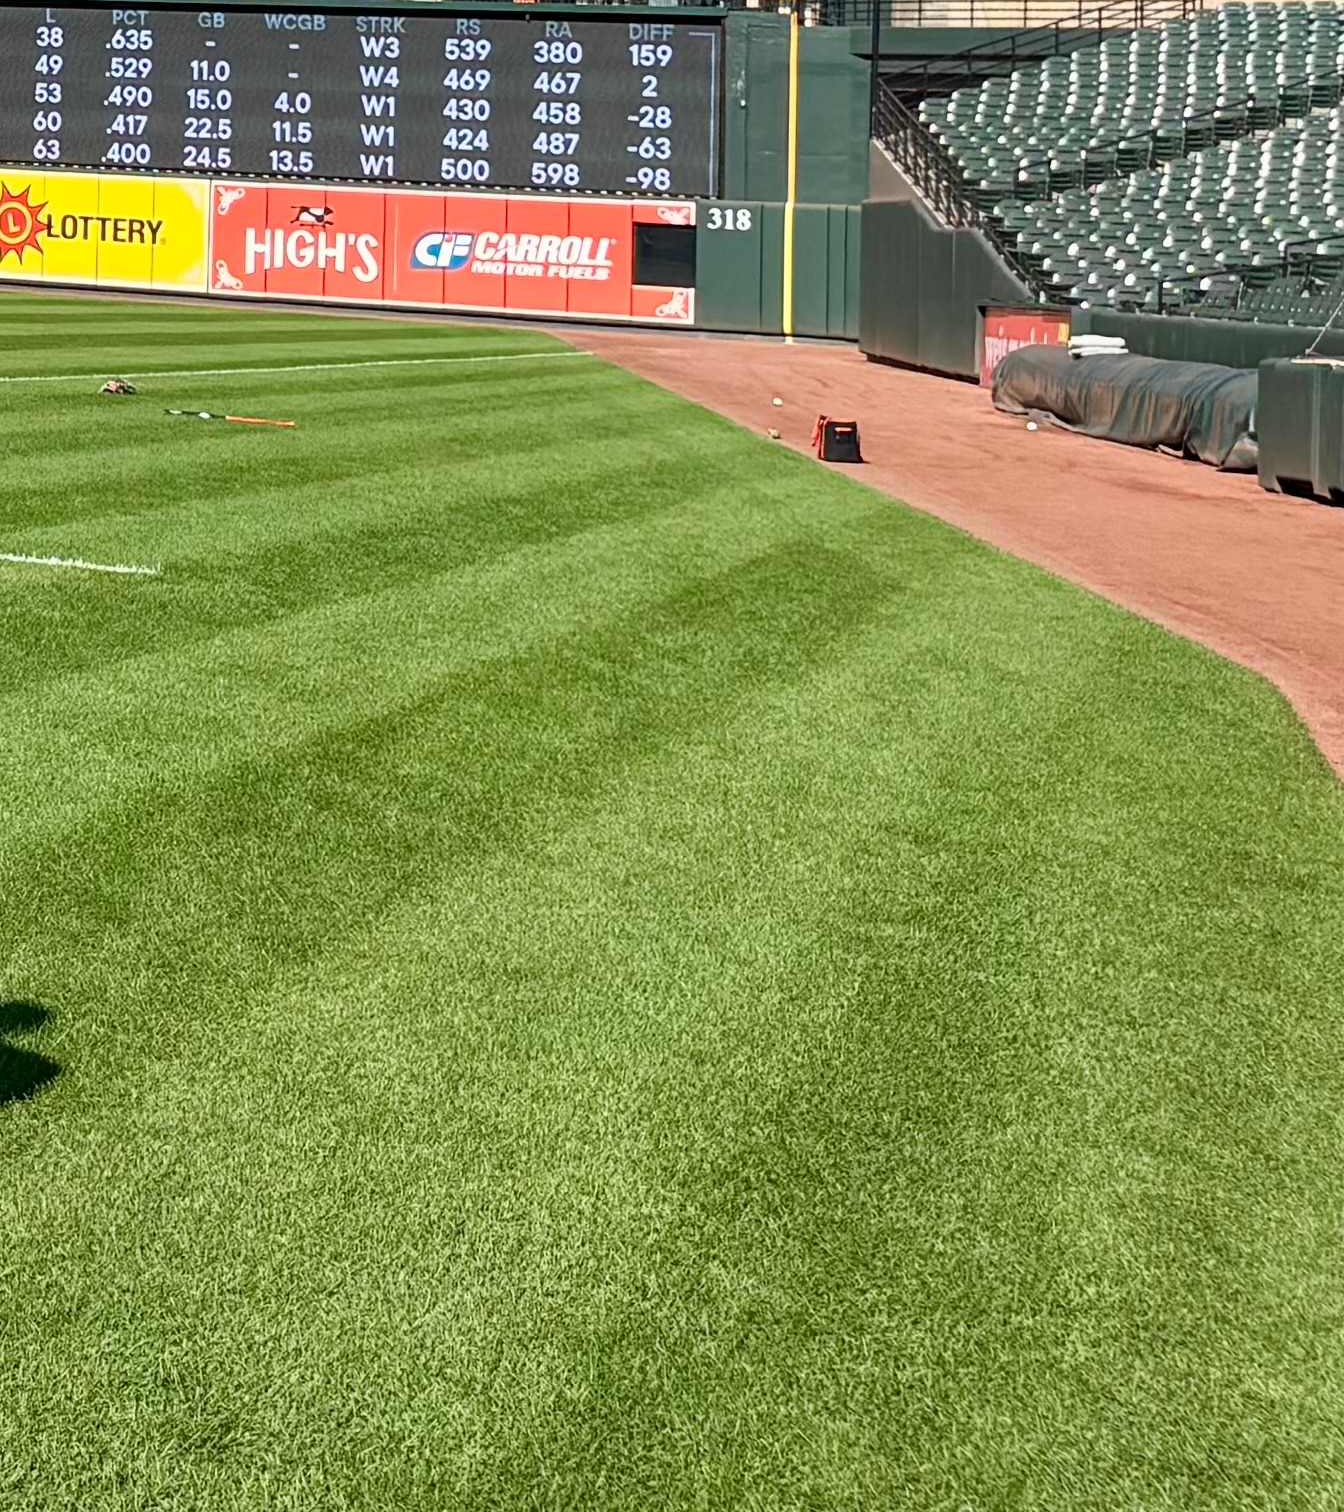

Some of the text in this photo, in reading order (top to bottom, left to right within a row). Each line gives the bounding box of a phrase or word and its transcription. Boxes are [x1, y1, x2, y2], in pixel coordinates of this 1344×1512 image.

[112, 9, 149, 26] PCT
[197, 11, 225, 28] GB
[264, 13, 326, 31] WCGB
[356, 15, 406, 34] STRK
[456, 18, 481, 36] RS
[545, 20, 573, 39] RA
[628, 23, 675, 42] DIFF
[36, 26, 64, 48] 38
[105, 28, 153, 51] .635
[360, 35, 400, 59] W3
[444, 38, 492, 61] 539
[533, 40, 583, 64] 380
[628, 44, 673, 67] 159
[34, 54, 63, 75] 49
[105, 56, 153, 79] .529
[190, 59, 231, 82] 11.0
[359, 65, 400, 88] W4
[443, 68, 491, 91] 469
[533, 71, 581, 95] 467
[641, 74, 658, 98] 2
[34, 82, 62, 104] 53
[103, 85, 153, 108] .490
[186, 88, 232, 111] 15.0
[274, 91, 312, 114] 4.0
[361, 94, 395, 117] W1
[442, 98, 491, 122] 430
[532, 101, 581, 125] 458
[627, 105, 672, 129] -28
[33, 110, 62, 132] 60
[106, 113, 148, 136] .417
[184, 116, 232, 140] 22.5
[272, 120, 312, 144] 11.5
[360, 123, 395, 147] W1
[442, 127, 489, 151] 424
[532, 131, 580, 155] 487
[626, 136, 672, 160] -63
[33, 138, 60, 160] 63
[101, 142, 151, 165] .400
[183, 145, 232, 169] 24.5
[269, 149, 314, 173] 13.5
[359, 154, 394, 177] W1
[441, 158, 490, 182] 500
[531, 162, 580, 186] 598
[625, 166, 671, 191] -98
[47, 214, 162, 245] LOTTERY
[707, 208, 752, 231] 318
[245, 228, 379, 283] HIGH'S
[473, 231, 613, 266] CARROLL
[471, 262, 610, 280] MOTOR FUELS
